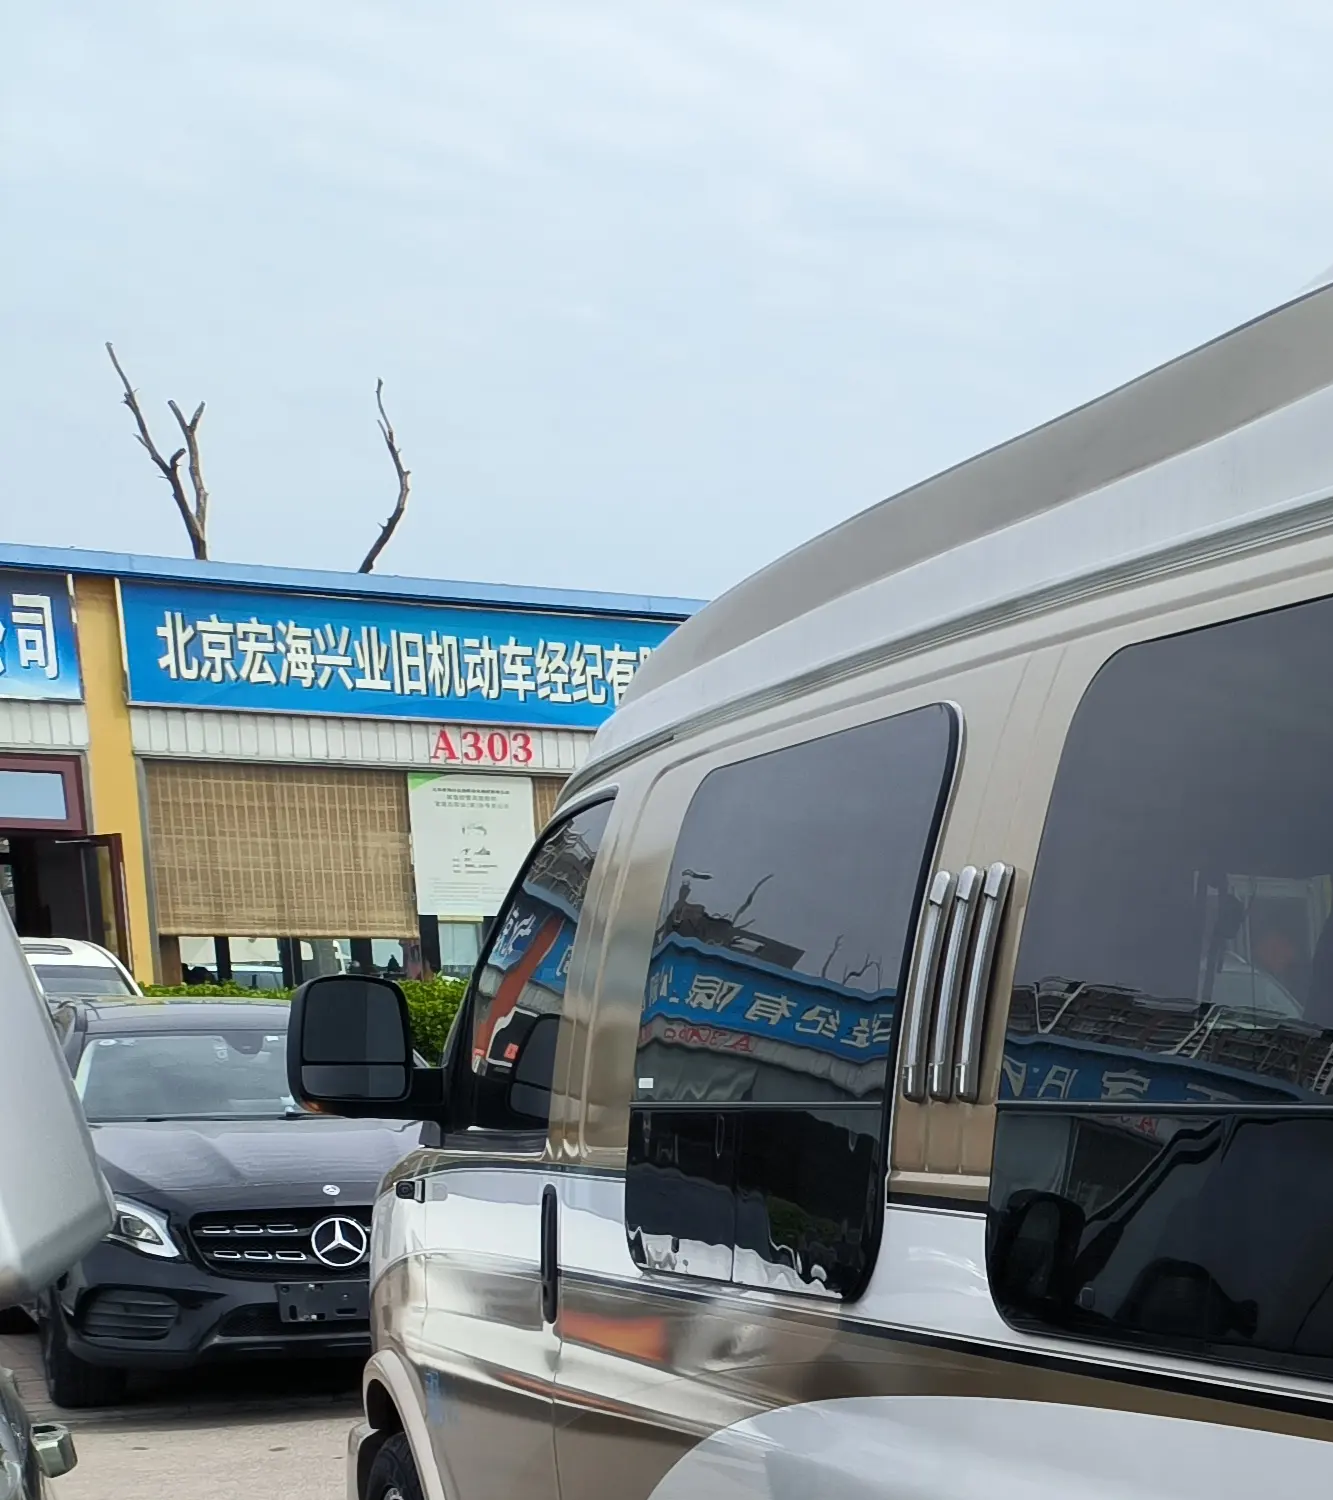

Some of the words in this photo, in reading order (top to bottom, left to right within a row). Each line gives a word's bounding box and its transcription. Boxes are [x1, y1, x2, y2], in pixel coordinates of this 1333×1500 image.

[0, 591, 58, 680] 司
[156, 610, 656, 707] 北京宏海兴业旧机动车经纪有
[430, 729, 533, 764] A303
